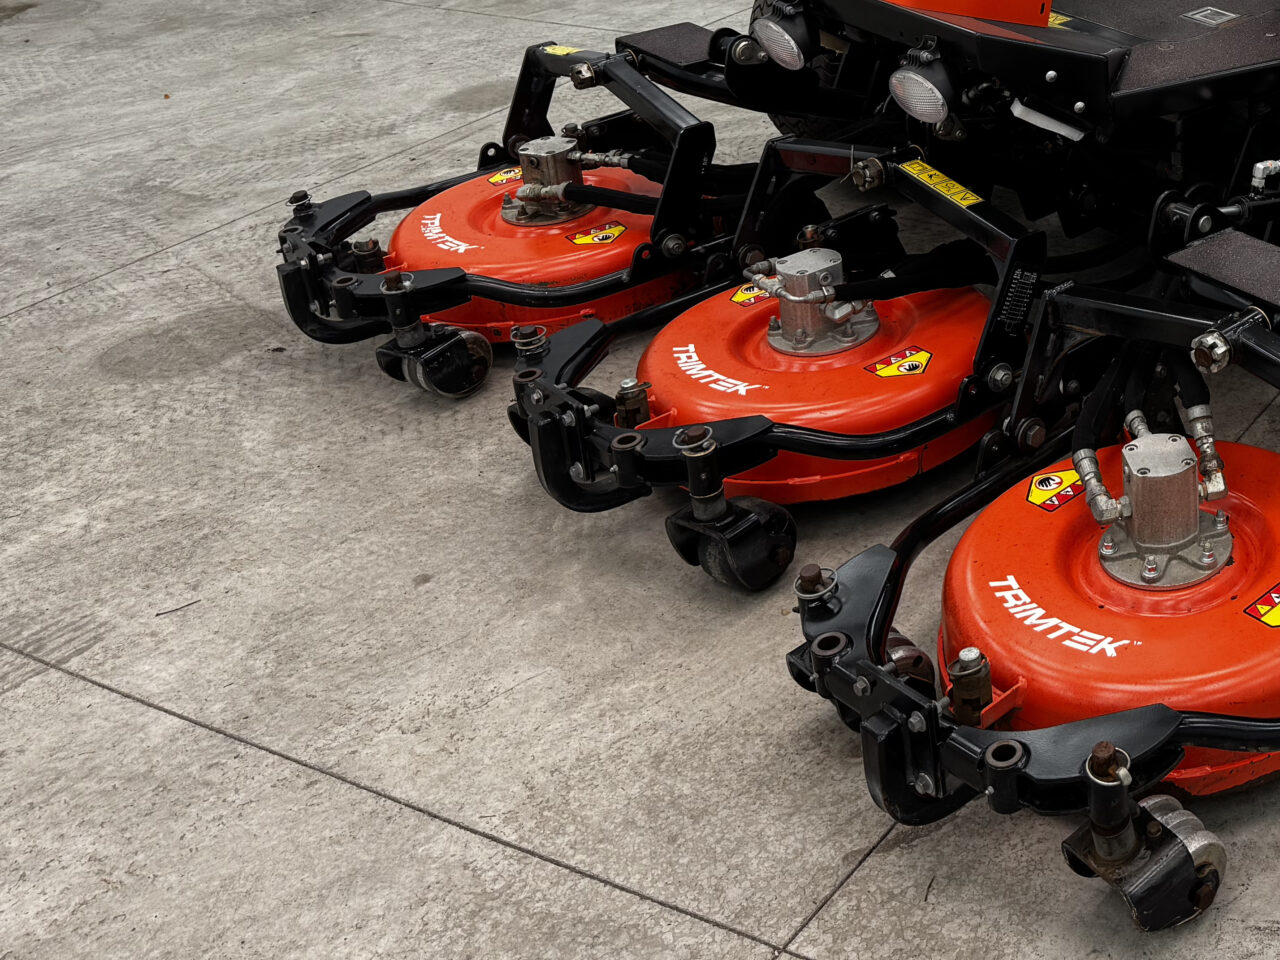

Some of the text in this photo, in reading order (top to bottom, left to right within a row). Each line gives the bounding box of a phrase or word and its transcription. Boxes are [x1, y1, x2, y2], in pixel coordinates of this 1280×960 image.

[420, 213, 480, 254] TRIMTEK
[672, 343, 761, 396] TRIMTEK
[988, 574, 1131, 658] TRIMTEK
